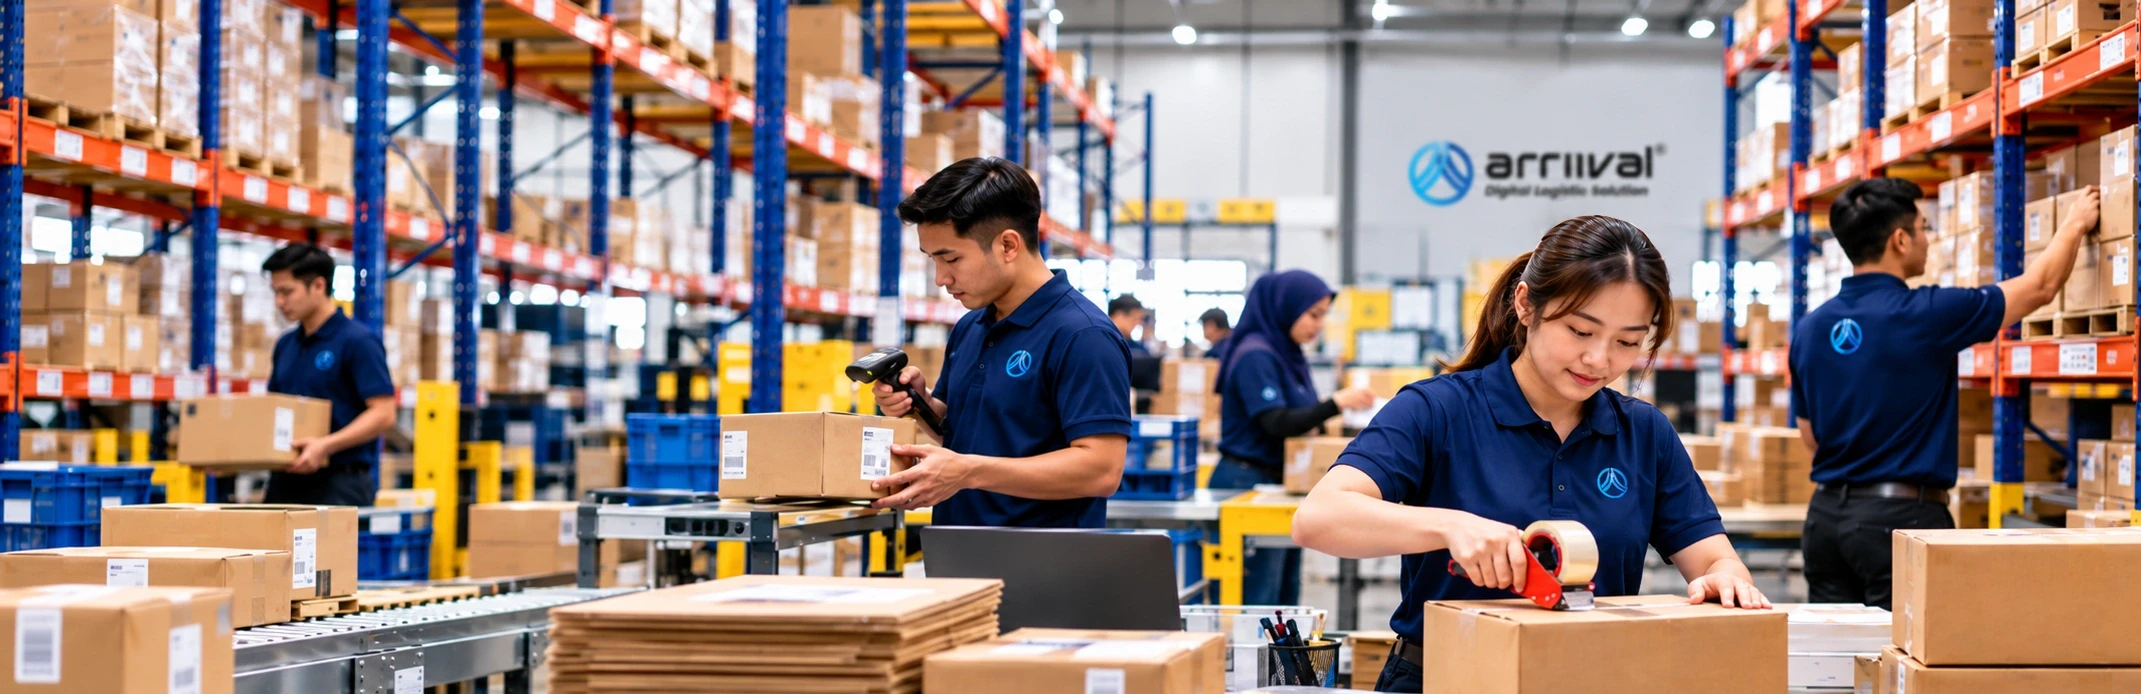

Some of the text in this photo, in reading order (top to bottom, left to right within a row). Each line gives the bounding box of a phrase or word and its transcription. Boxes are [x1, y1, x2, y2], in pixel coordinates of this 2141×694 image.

[1485, 185, 1649, 199] Digital Logistic Solution
